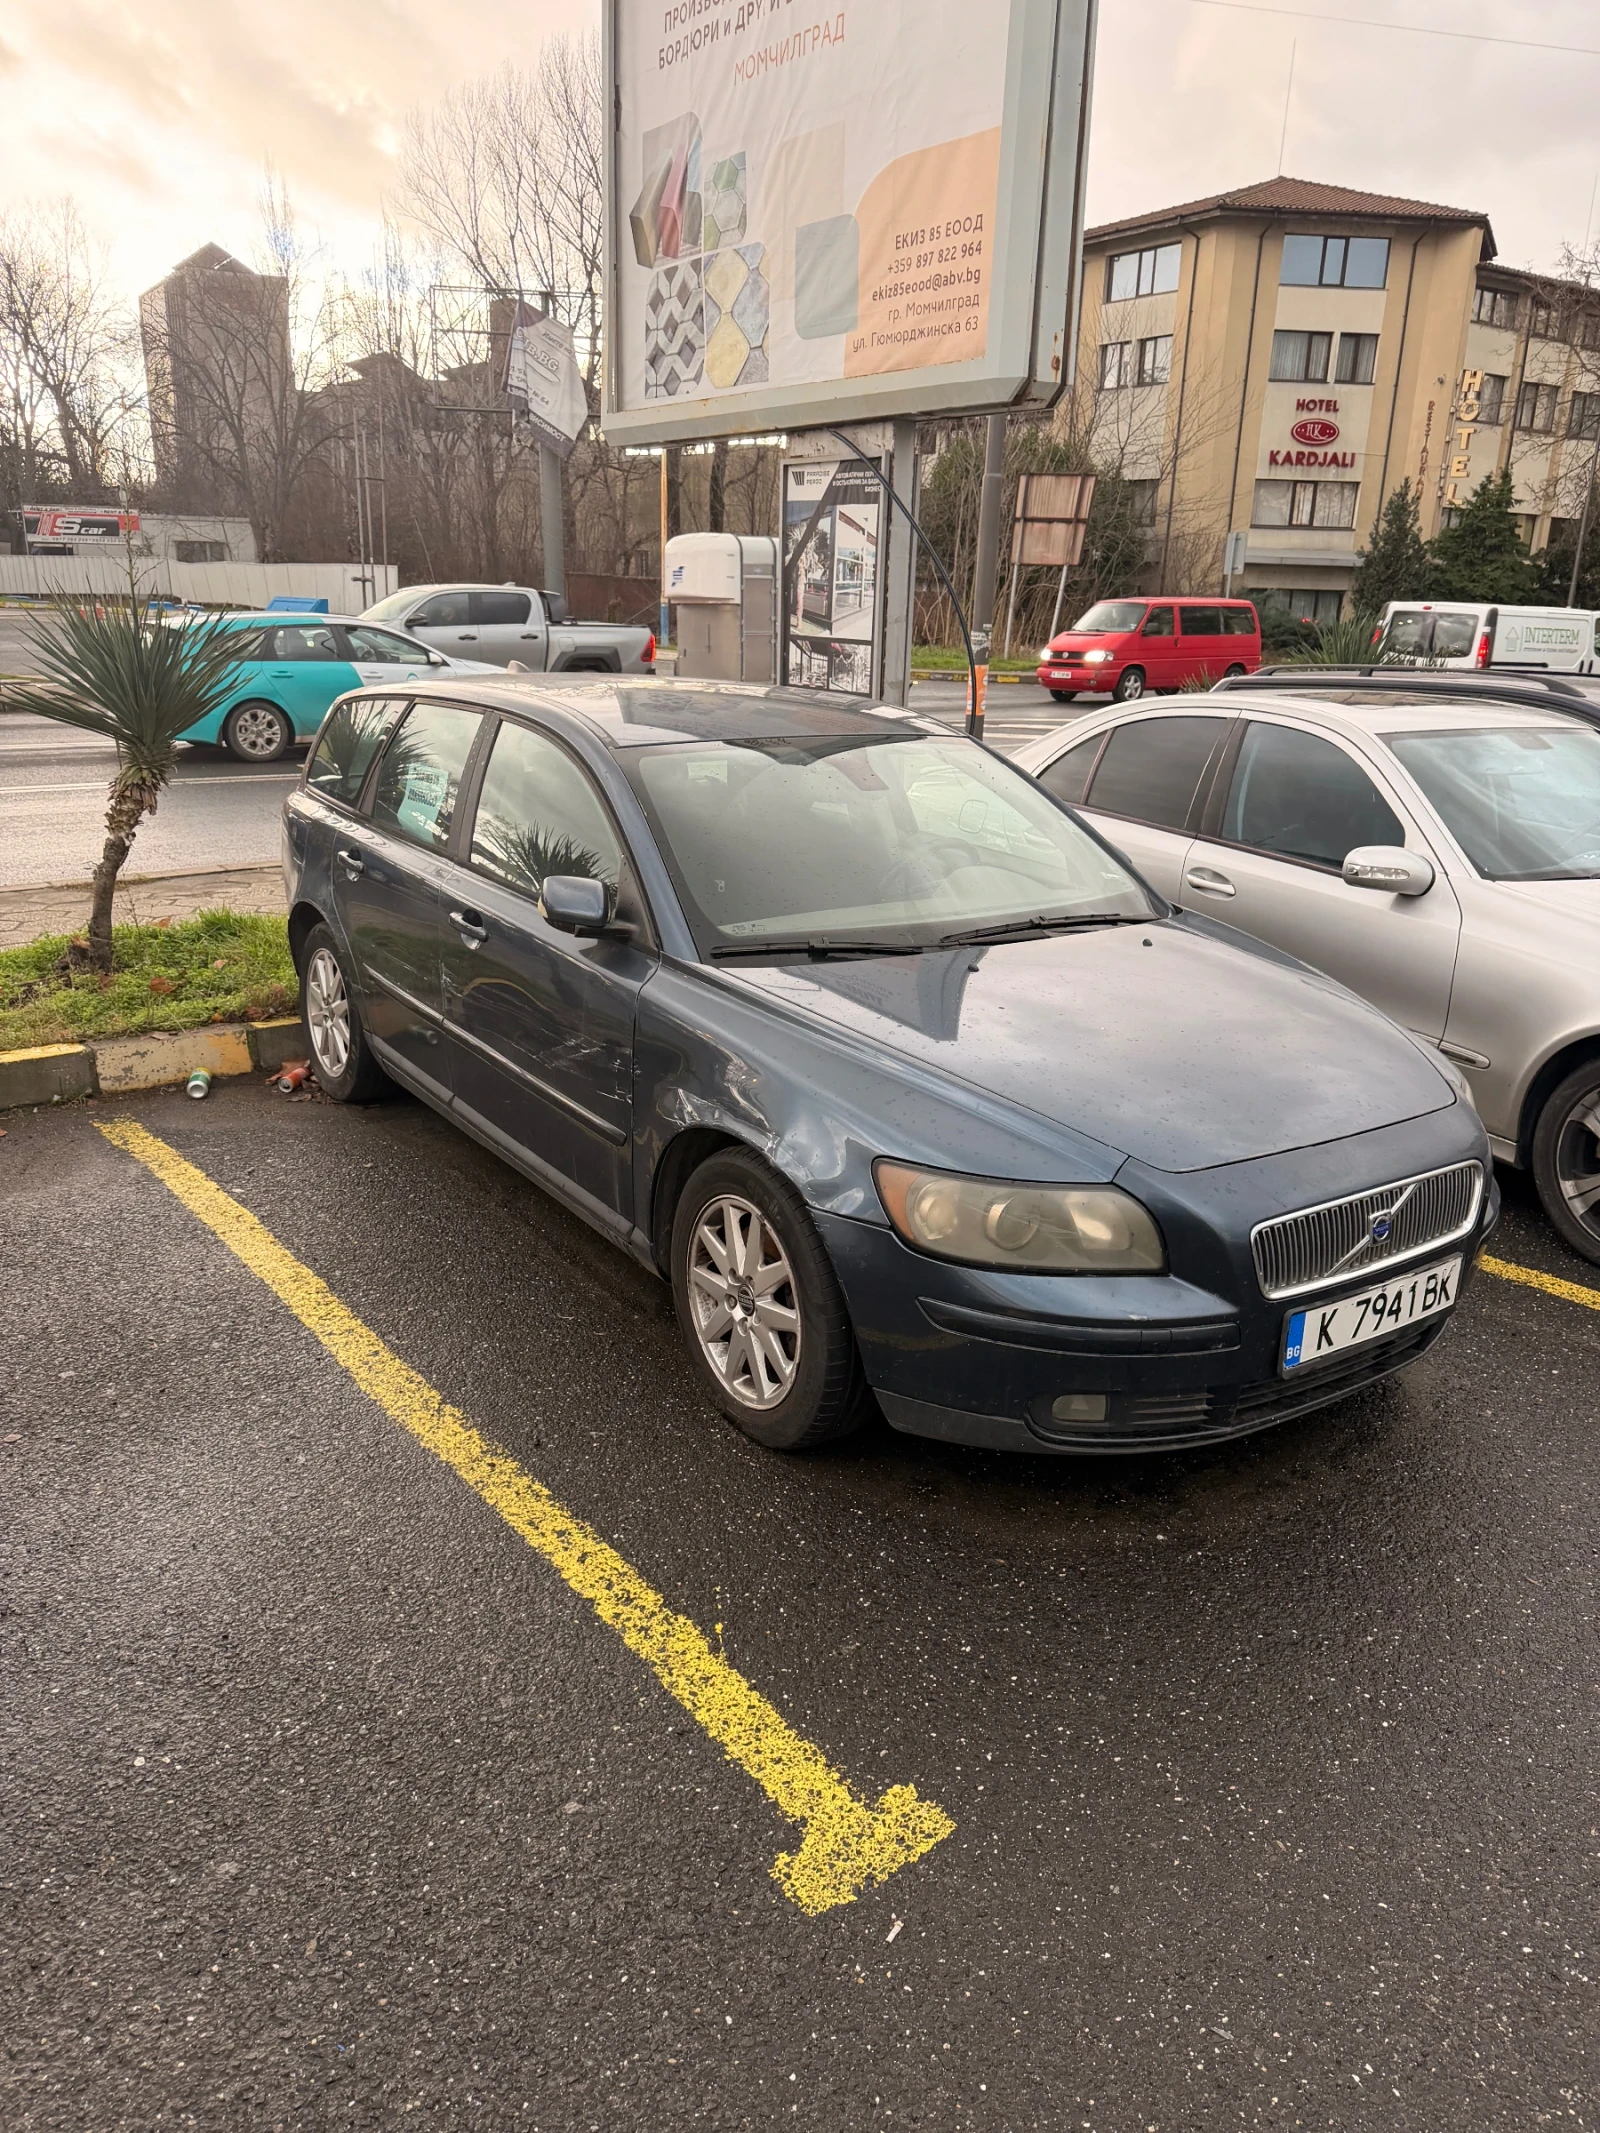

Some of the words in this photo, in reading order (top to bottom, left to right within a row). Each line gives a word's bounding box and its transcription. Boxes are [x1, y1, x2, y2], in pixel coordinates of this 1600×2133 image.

[659, 19, 719, 70] БОРДЮРИ
[723, 19, 731, 36] и
[734, 13, 845, 86] МОМЧИЛГРАД
[895, 229, 926, 250] ЕКИЗ
[929, 225, 942, 241] 85
[945, 213, 983, 237] ЕООД
[888, 257, 912, 274] +359
[916, 251, 934, 269] 897
[938, 246, 957, 263] 822
[961, 240, 982, 259] 964
[872, 266, 981, 301] ekiz85eood@abv.bg
[888, 309, 902, 324] гр.
[906, 294, 980, 318] Момчилград
[853, 337, 868, 353] ул.
[871, 321, 961, 348] Гюмюрджинска
[965, 315, 979, 332] 63
[1295, 398, 1339, 412] HOTEL
[1445, 368, 1484, 506] HOTEL
[1269, 449, 1356, 468] KARDJALI
[1524, 627, 1580, 645] INTERTERM
[1316, 1308, 1338, 1351] K
[1286, 1345, 1301, 1360] BG
